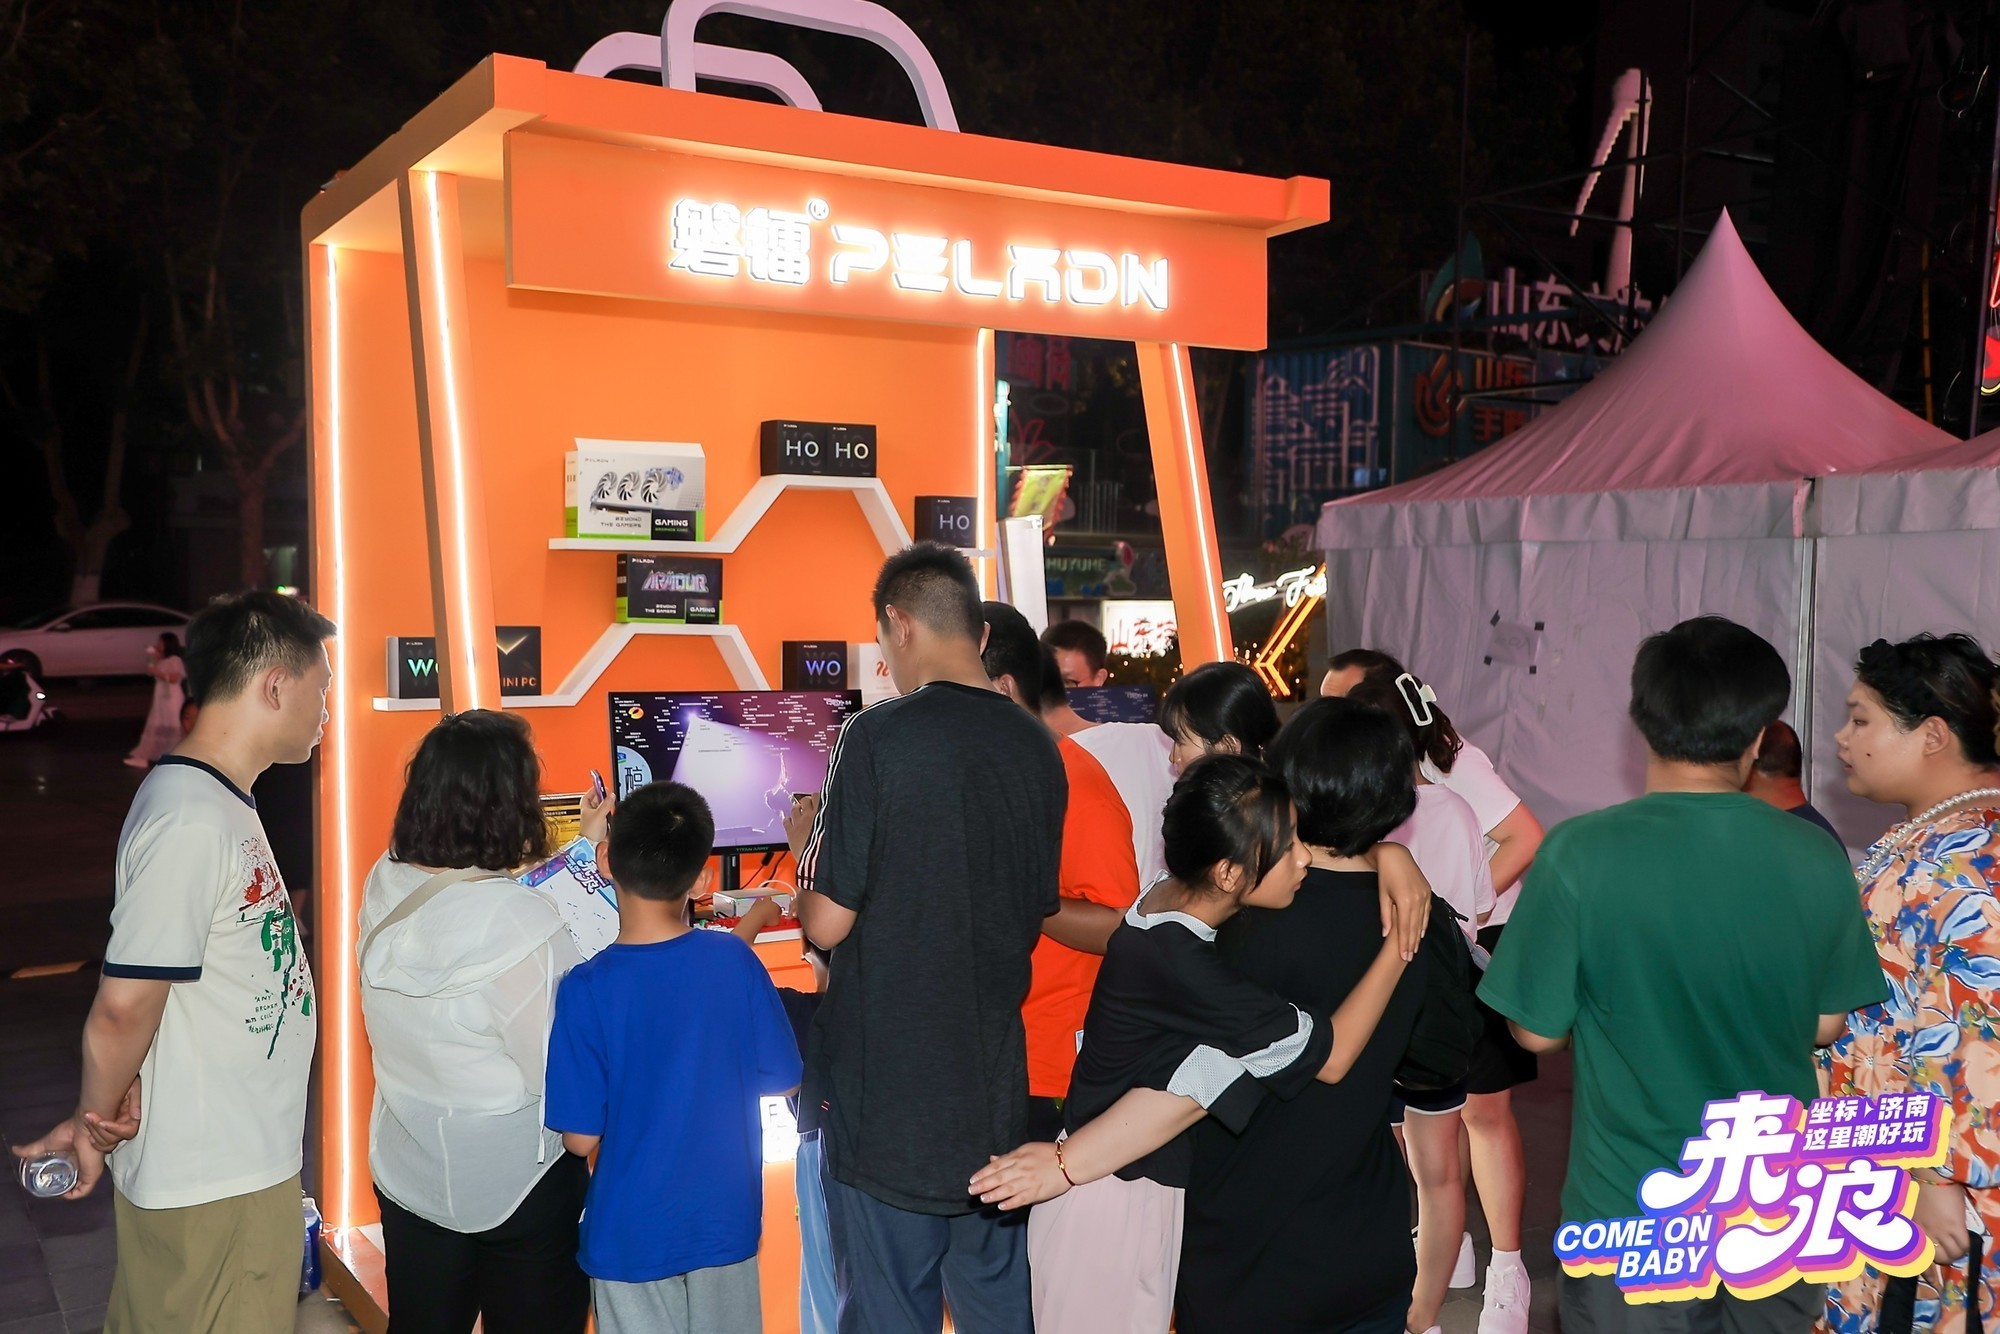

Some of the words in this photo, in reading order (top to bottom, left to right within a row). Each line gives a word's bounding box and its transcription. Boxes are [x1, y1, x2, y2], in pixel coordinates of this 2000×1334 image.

[786, 439, 819, 457] HO
[835, 442, 869, 459] HO
[655, 518, 688, 527] GAMING
[939, 514, 970, 530] HO
[408, 658, 439, 678] W
[805, 660, 841, 676] WO
[521, 677, 537, 687] PC
